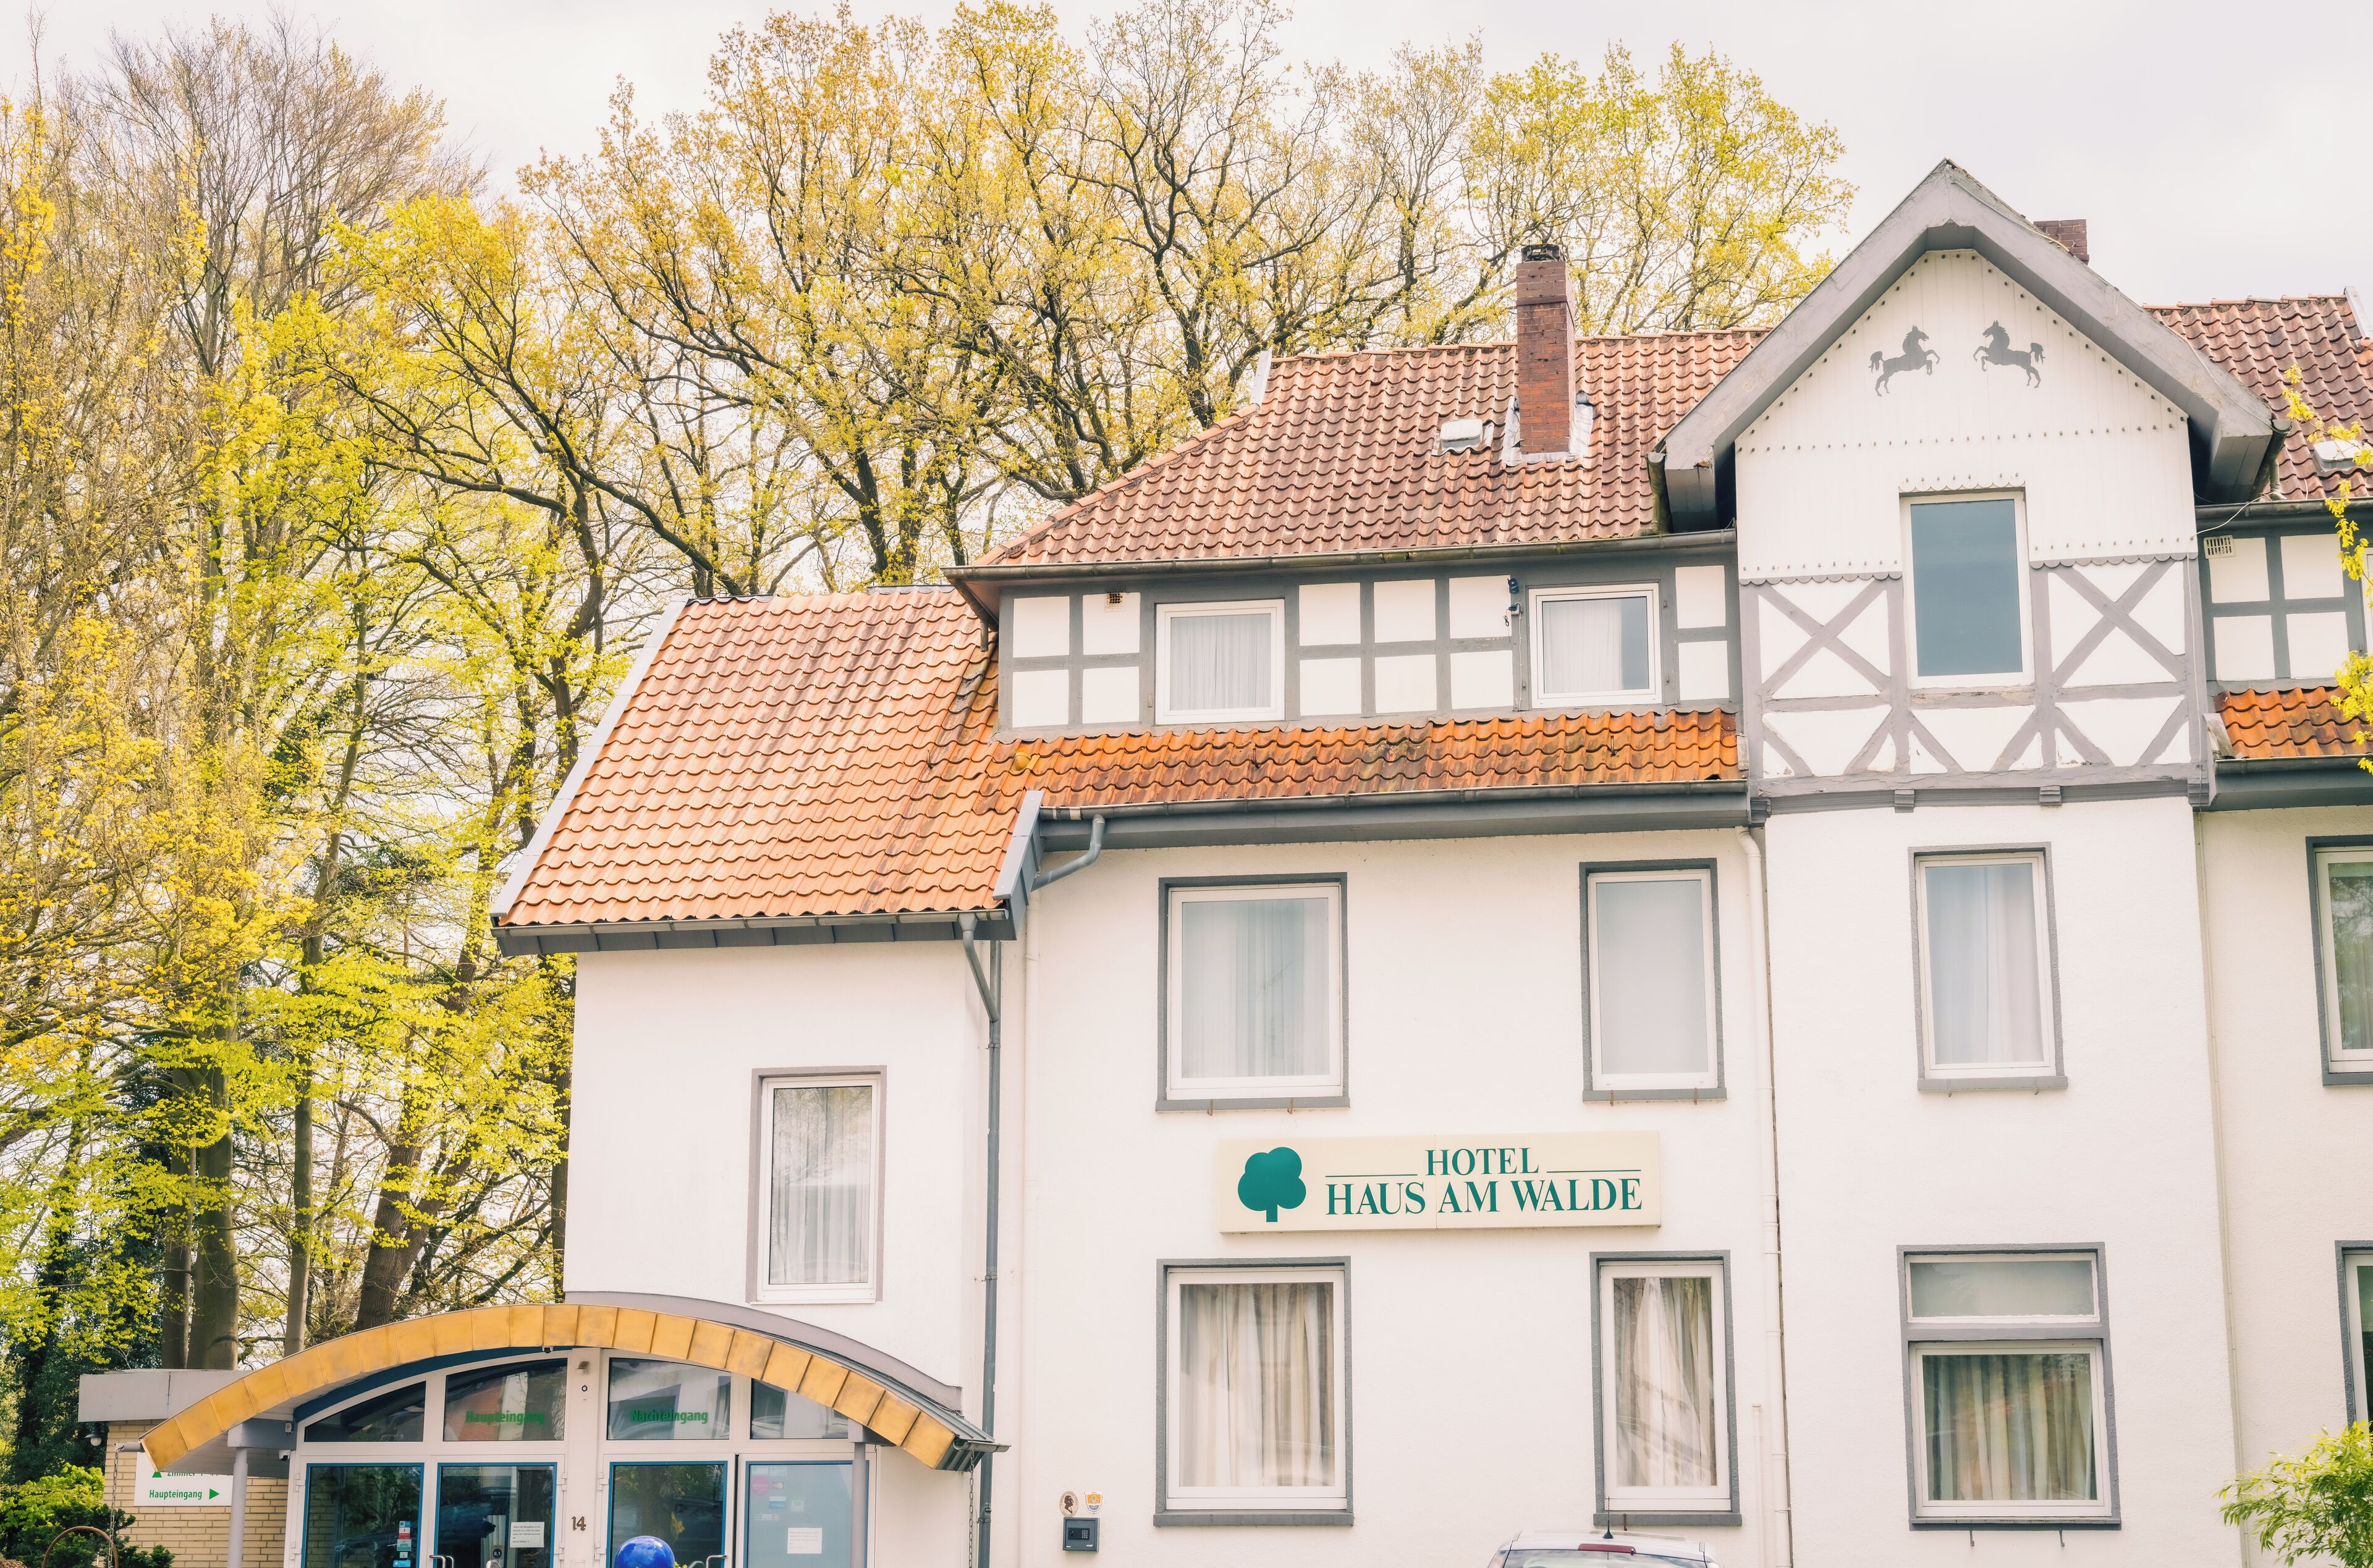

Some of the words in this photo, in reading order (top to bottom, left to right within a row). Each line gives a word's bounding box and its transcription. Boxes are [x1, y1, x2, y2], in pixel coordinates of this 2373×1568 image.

[1425, 1148, 1539, 1176] HOTEL
[1325, 1181, 1426, 1215] HAUS
[1437, 1181, 1500, 1213] AM
[1510, 1178, 1643, 1212] WALDE
[465, 1410, 544, 1426] Haupteingang
[632, 1409, 709, 1424] Nachteingang
[149, 1490, 203, 1500] Haupteingang
[571, 1515, 586, 1532] 14
